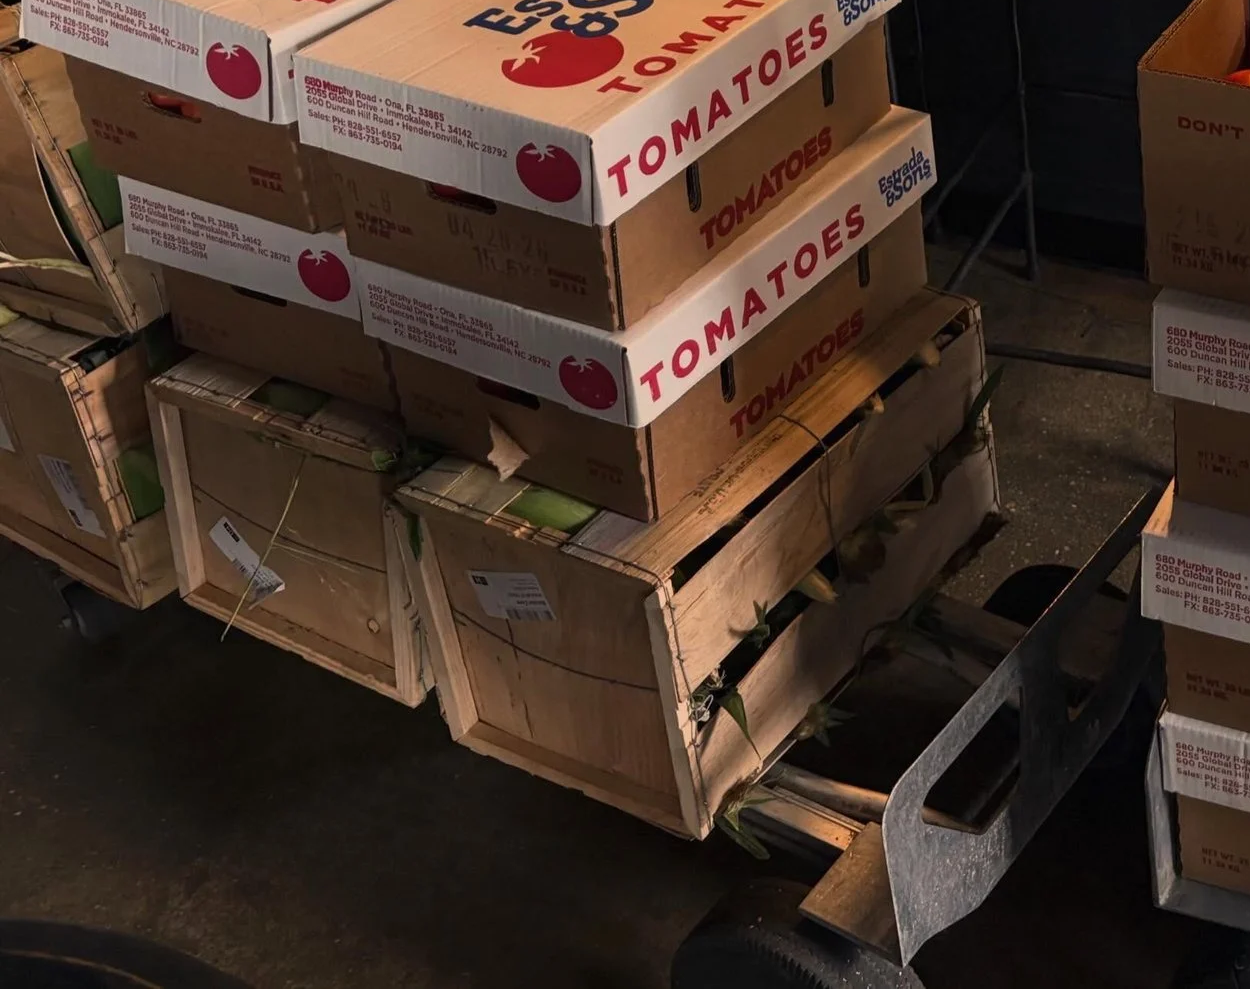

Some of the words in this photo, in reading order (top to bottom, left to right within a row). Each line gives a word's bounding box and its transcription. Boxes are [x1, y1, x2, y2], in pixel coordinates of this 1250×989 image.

[114, 1, 123, 12] FL
[124, 5, 146, 19] 33865
[306, 85, 326, 98] 2055
[328, 92, 354, 106] Global
[356, 99, 378, 112] Drive
[434, 121, 445, 131] FL
[447, 124, 472, 139] 34142
[306, 94, 323, 106] 600
[325, 100, 355, 116] Duncan
[357, 109, 370, 120] Hill
[372, 113, 393, 126] Road
[466, 139, 479, 150] NC
[481, 143, 507, 158] 28792
[307, 108, 331, 122] Sales:
[331, 115, 345, 126] PH:
[355, 89, 376, 103] Road
[384, 98, 404, 112] Ona,
[405, 103, 416, 114] FL
[418, 106, 444, 121] 33865
[607, 14, 828, 197] TOMATOES
[1177, 116, 1244, 140] DON'T
[332, 124, 346, 135] FX:
[700, 126, 832, 249] TOMATOES
[878, 147, 924, 195] Estrada
[640, 204, 865, 402] TOMATOES
[729, 308, 864, 438] TOMATOES
[1155, 553, 1175, 564] 680
[1177, 558, 1213, 575] Murphy
[1215, 567, 1241, 580] Road
